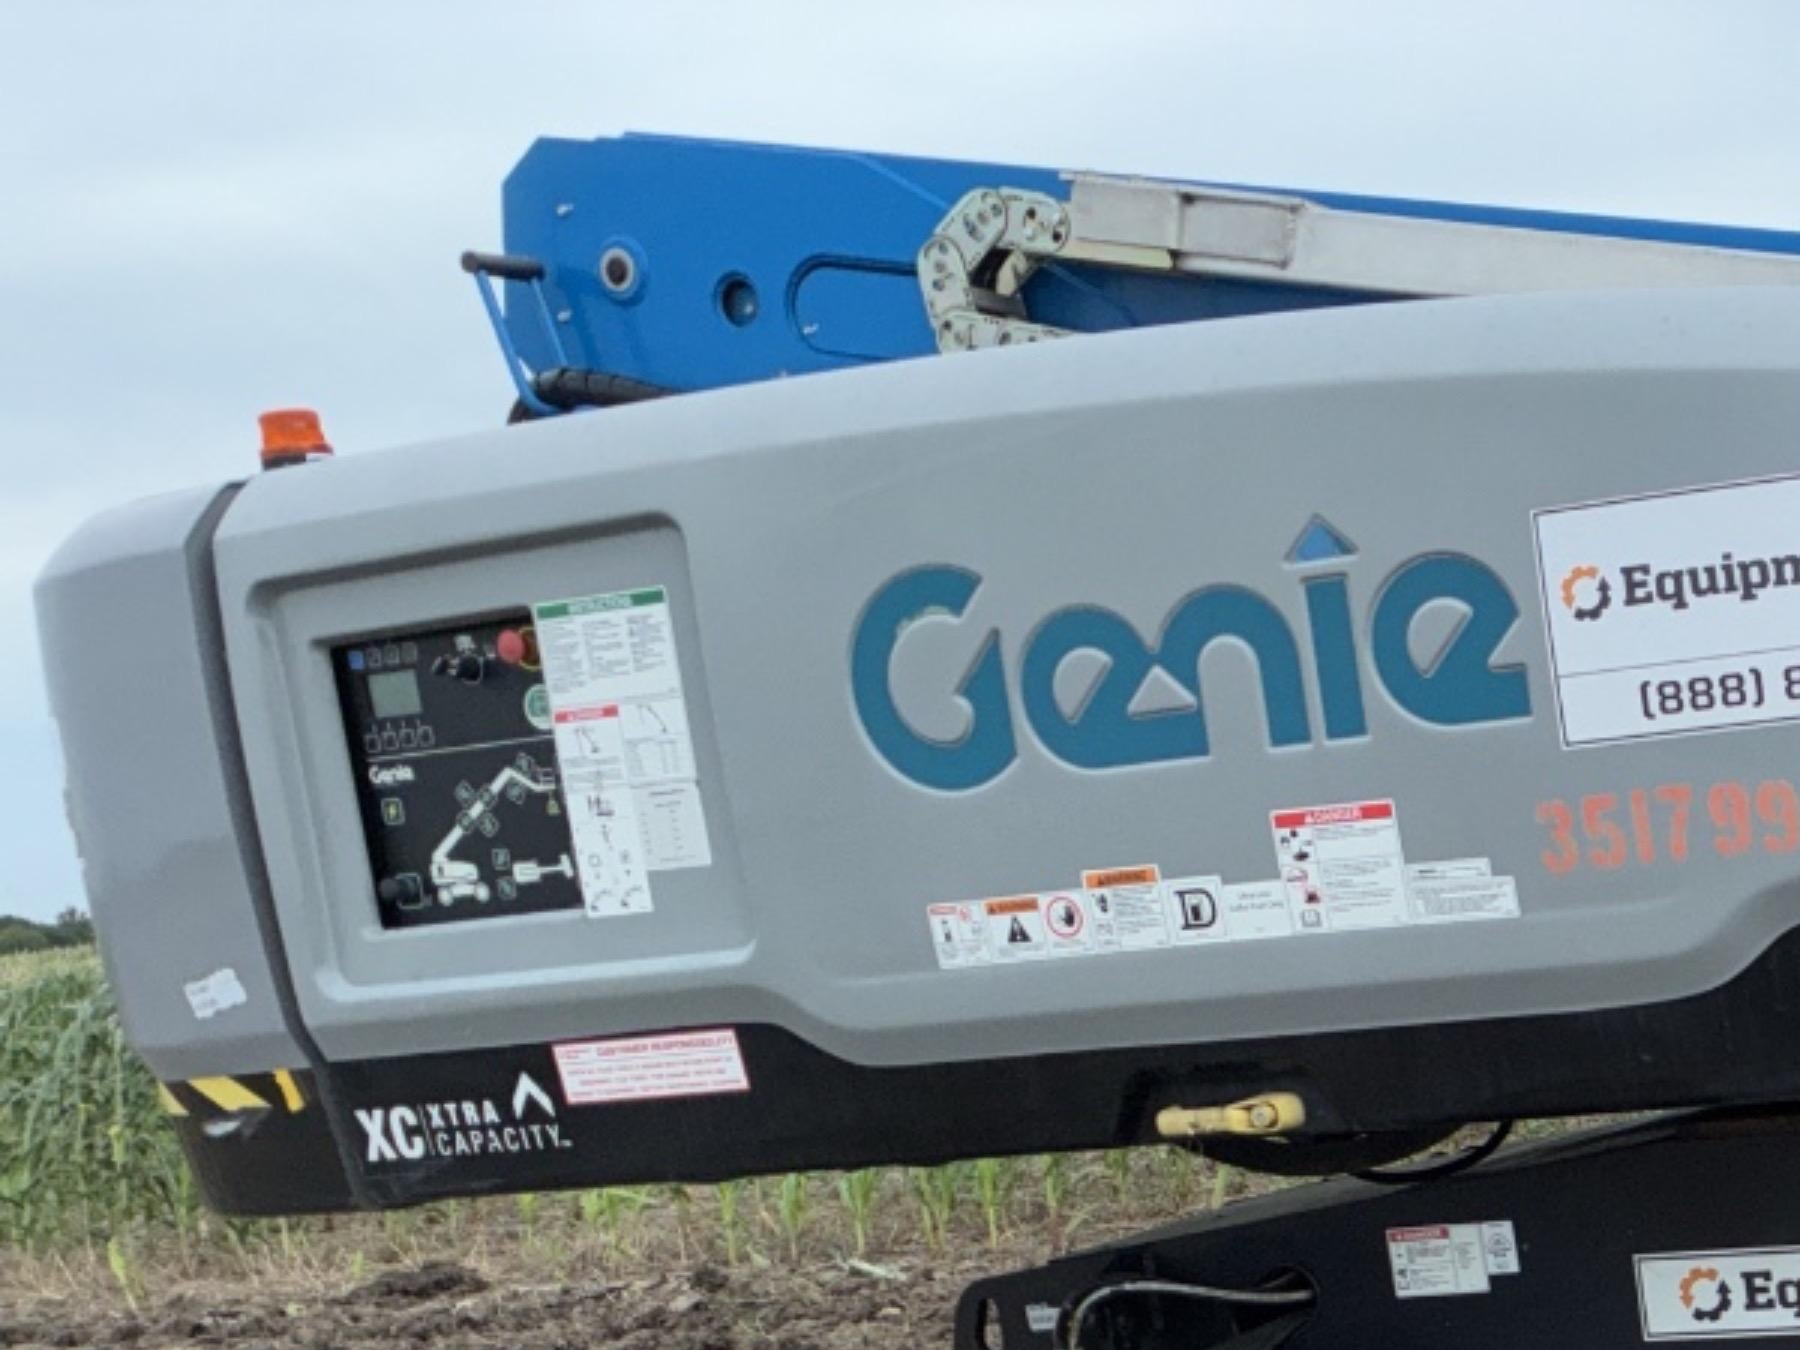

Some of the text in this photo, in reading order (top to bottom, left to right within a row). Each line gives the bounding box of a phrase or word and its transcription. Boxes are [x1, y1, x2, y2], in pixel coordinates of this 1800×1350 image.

[850, 513, 1532, 793] Genie
[1640, 666, 1765, 720] (888)
[353, 1104, 426, 1162] XC
[424, 1099, 501, 1130] XTRA
[436, 1123, 561, 1157] CAPACITY
